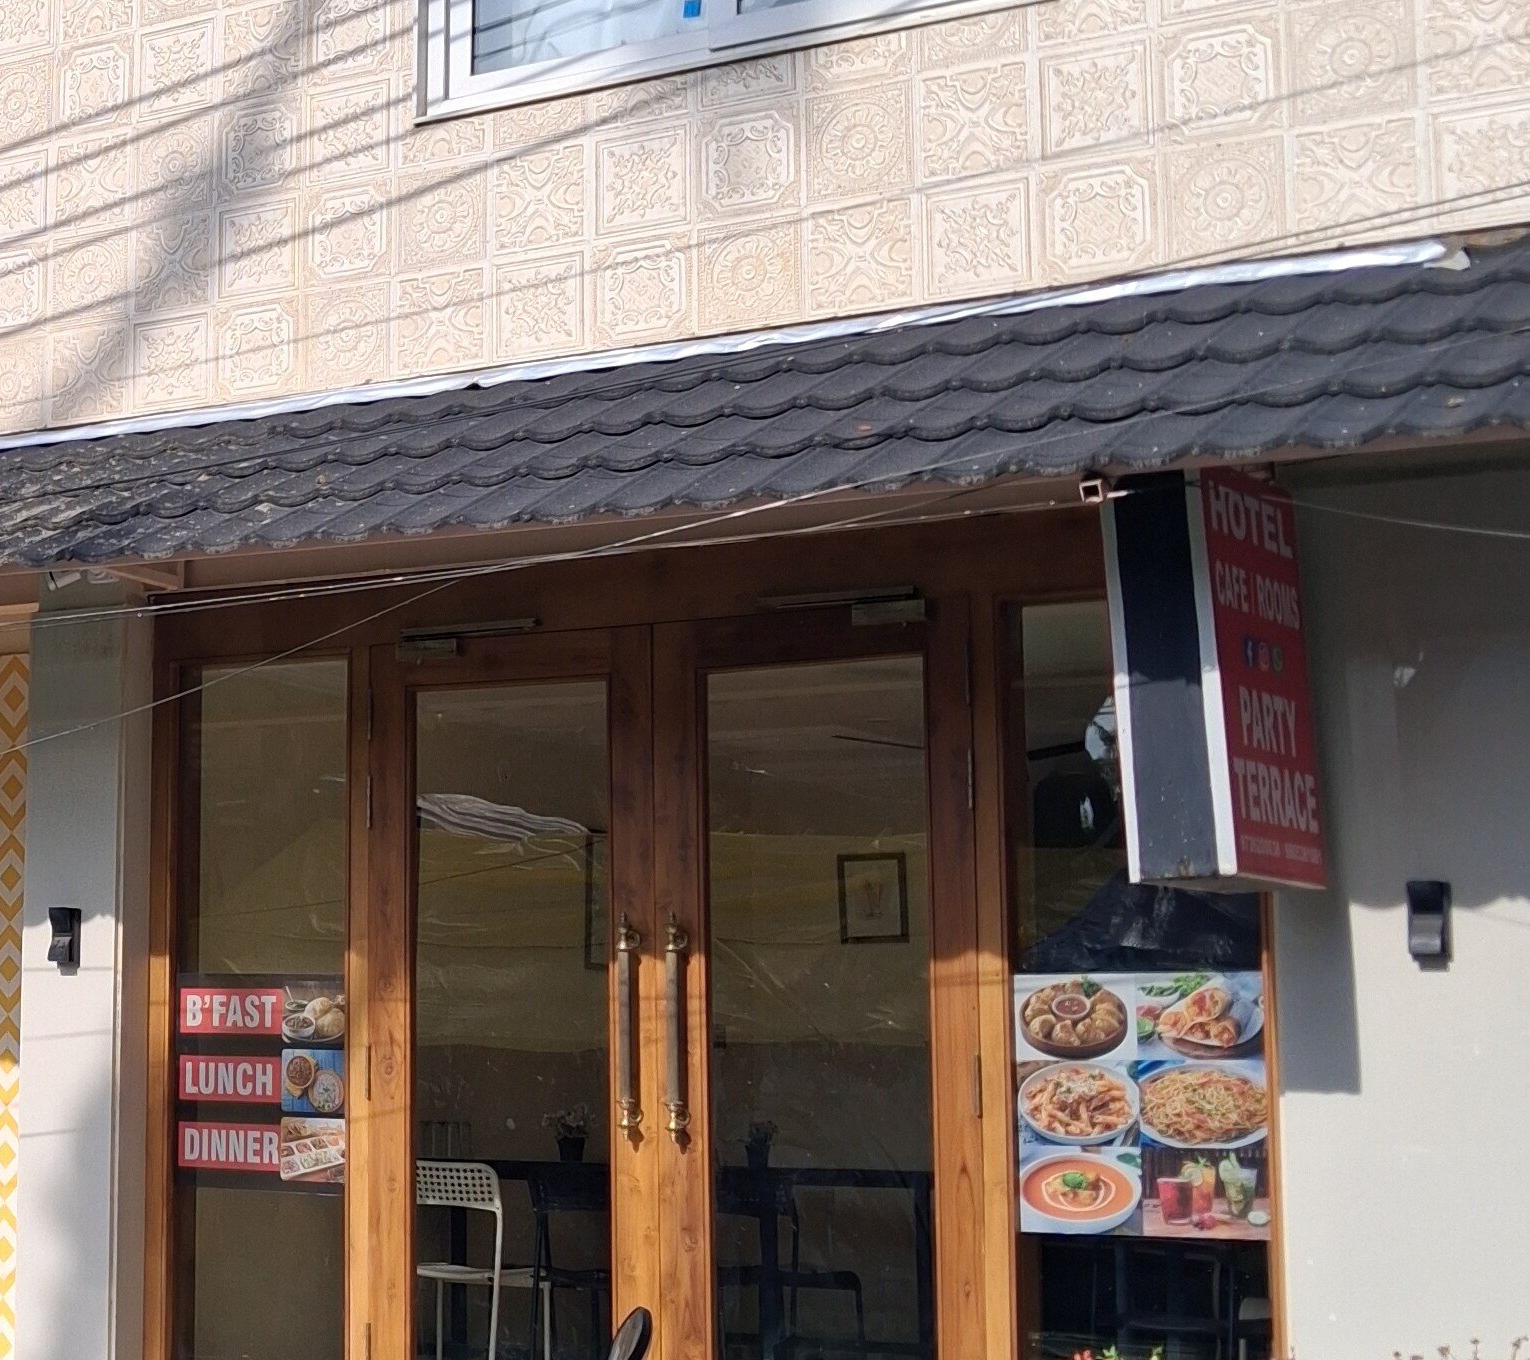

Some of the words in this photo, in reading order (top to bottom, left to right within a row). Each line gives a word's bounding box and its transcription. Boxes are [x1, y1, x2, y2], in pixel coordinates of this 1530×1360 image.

[1208, 479, 1294, 560] HOTEL
[1215, 560, 1248, 615] CAFE
[1256, 573, 1300, 632] ROOMS
[1238, 685, 1297, 759] PARTY
[1233, 757, 1319, 834] TERRACE
[186, 994, 276, 1028] B'FAST
[185, 1061, 272, 1096] LUNCH
[184, 1127, 279, 1165] DINNER
